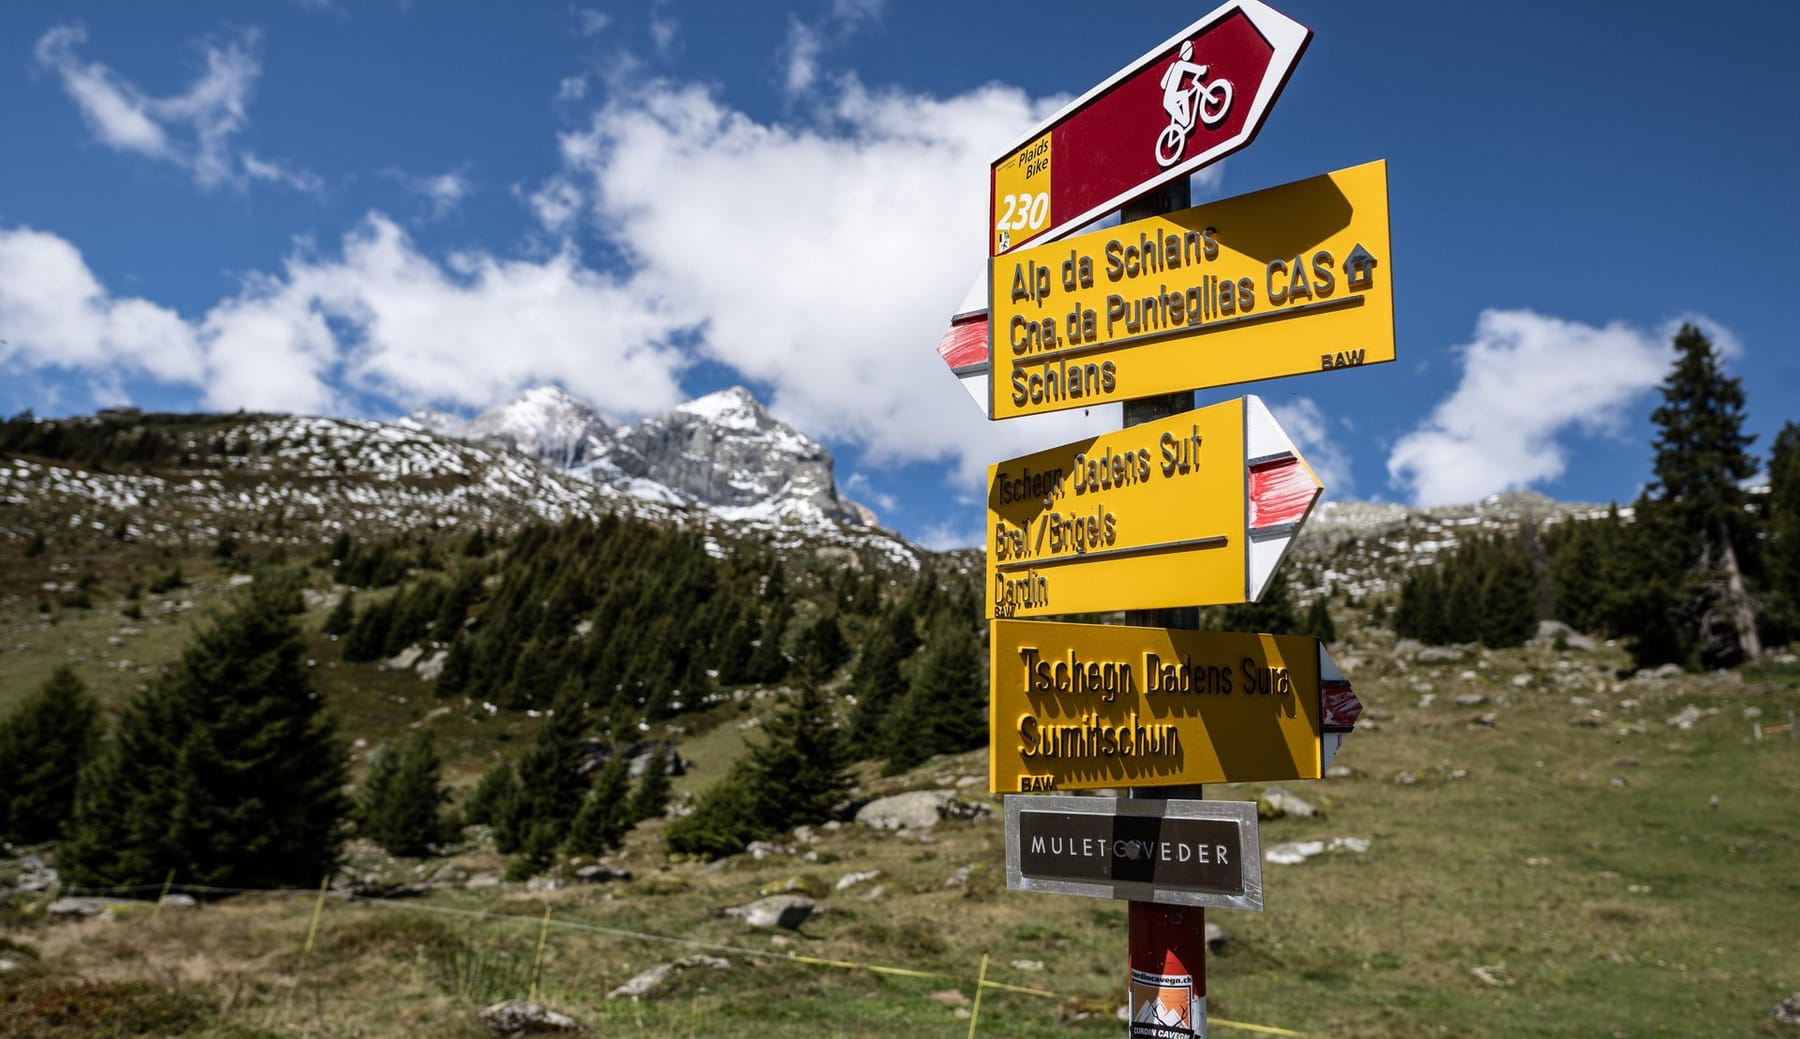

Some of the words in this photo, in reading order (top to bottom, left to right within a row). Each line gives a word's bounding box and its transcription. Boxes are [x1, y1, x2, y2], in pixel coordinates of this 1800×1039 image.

[1019, 139, 1049, 168] Plaids
[1026, 158, 1048, 180] Bike
[996, 192, 1049, 231] 230
[1011, 261, 1051, 307] Alp
[1061, 249, 1094, 293] da
[1105, 227, 1219, 282] Schlans
[1106, 274, 1255, 338] Punteglias
[1266, 250, 1335, 304] CAS
[1321, 348, 1365, 370] BAW
[1011, 358, 1116, 407] Schlans
[997, 467, 1065, 510] Tschegn
[1073, 446, 1151, 496] Dadens
[1160, 424, 1202, 478] Sut
[994, 569, 1048, 609] Dardin
[994, 605, 1015, 618] BAW
[1017, 646, 1133, 702] Tschegn
[1142, 651, 1233, 696] Dadens
[1240, 655, 1290, 697] Sura
[1017, 712, 1178, 759] Sumitschun
[1018, 774, 1056, 792] BAW
